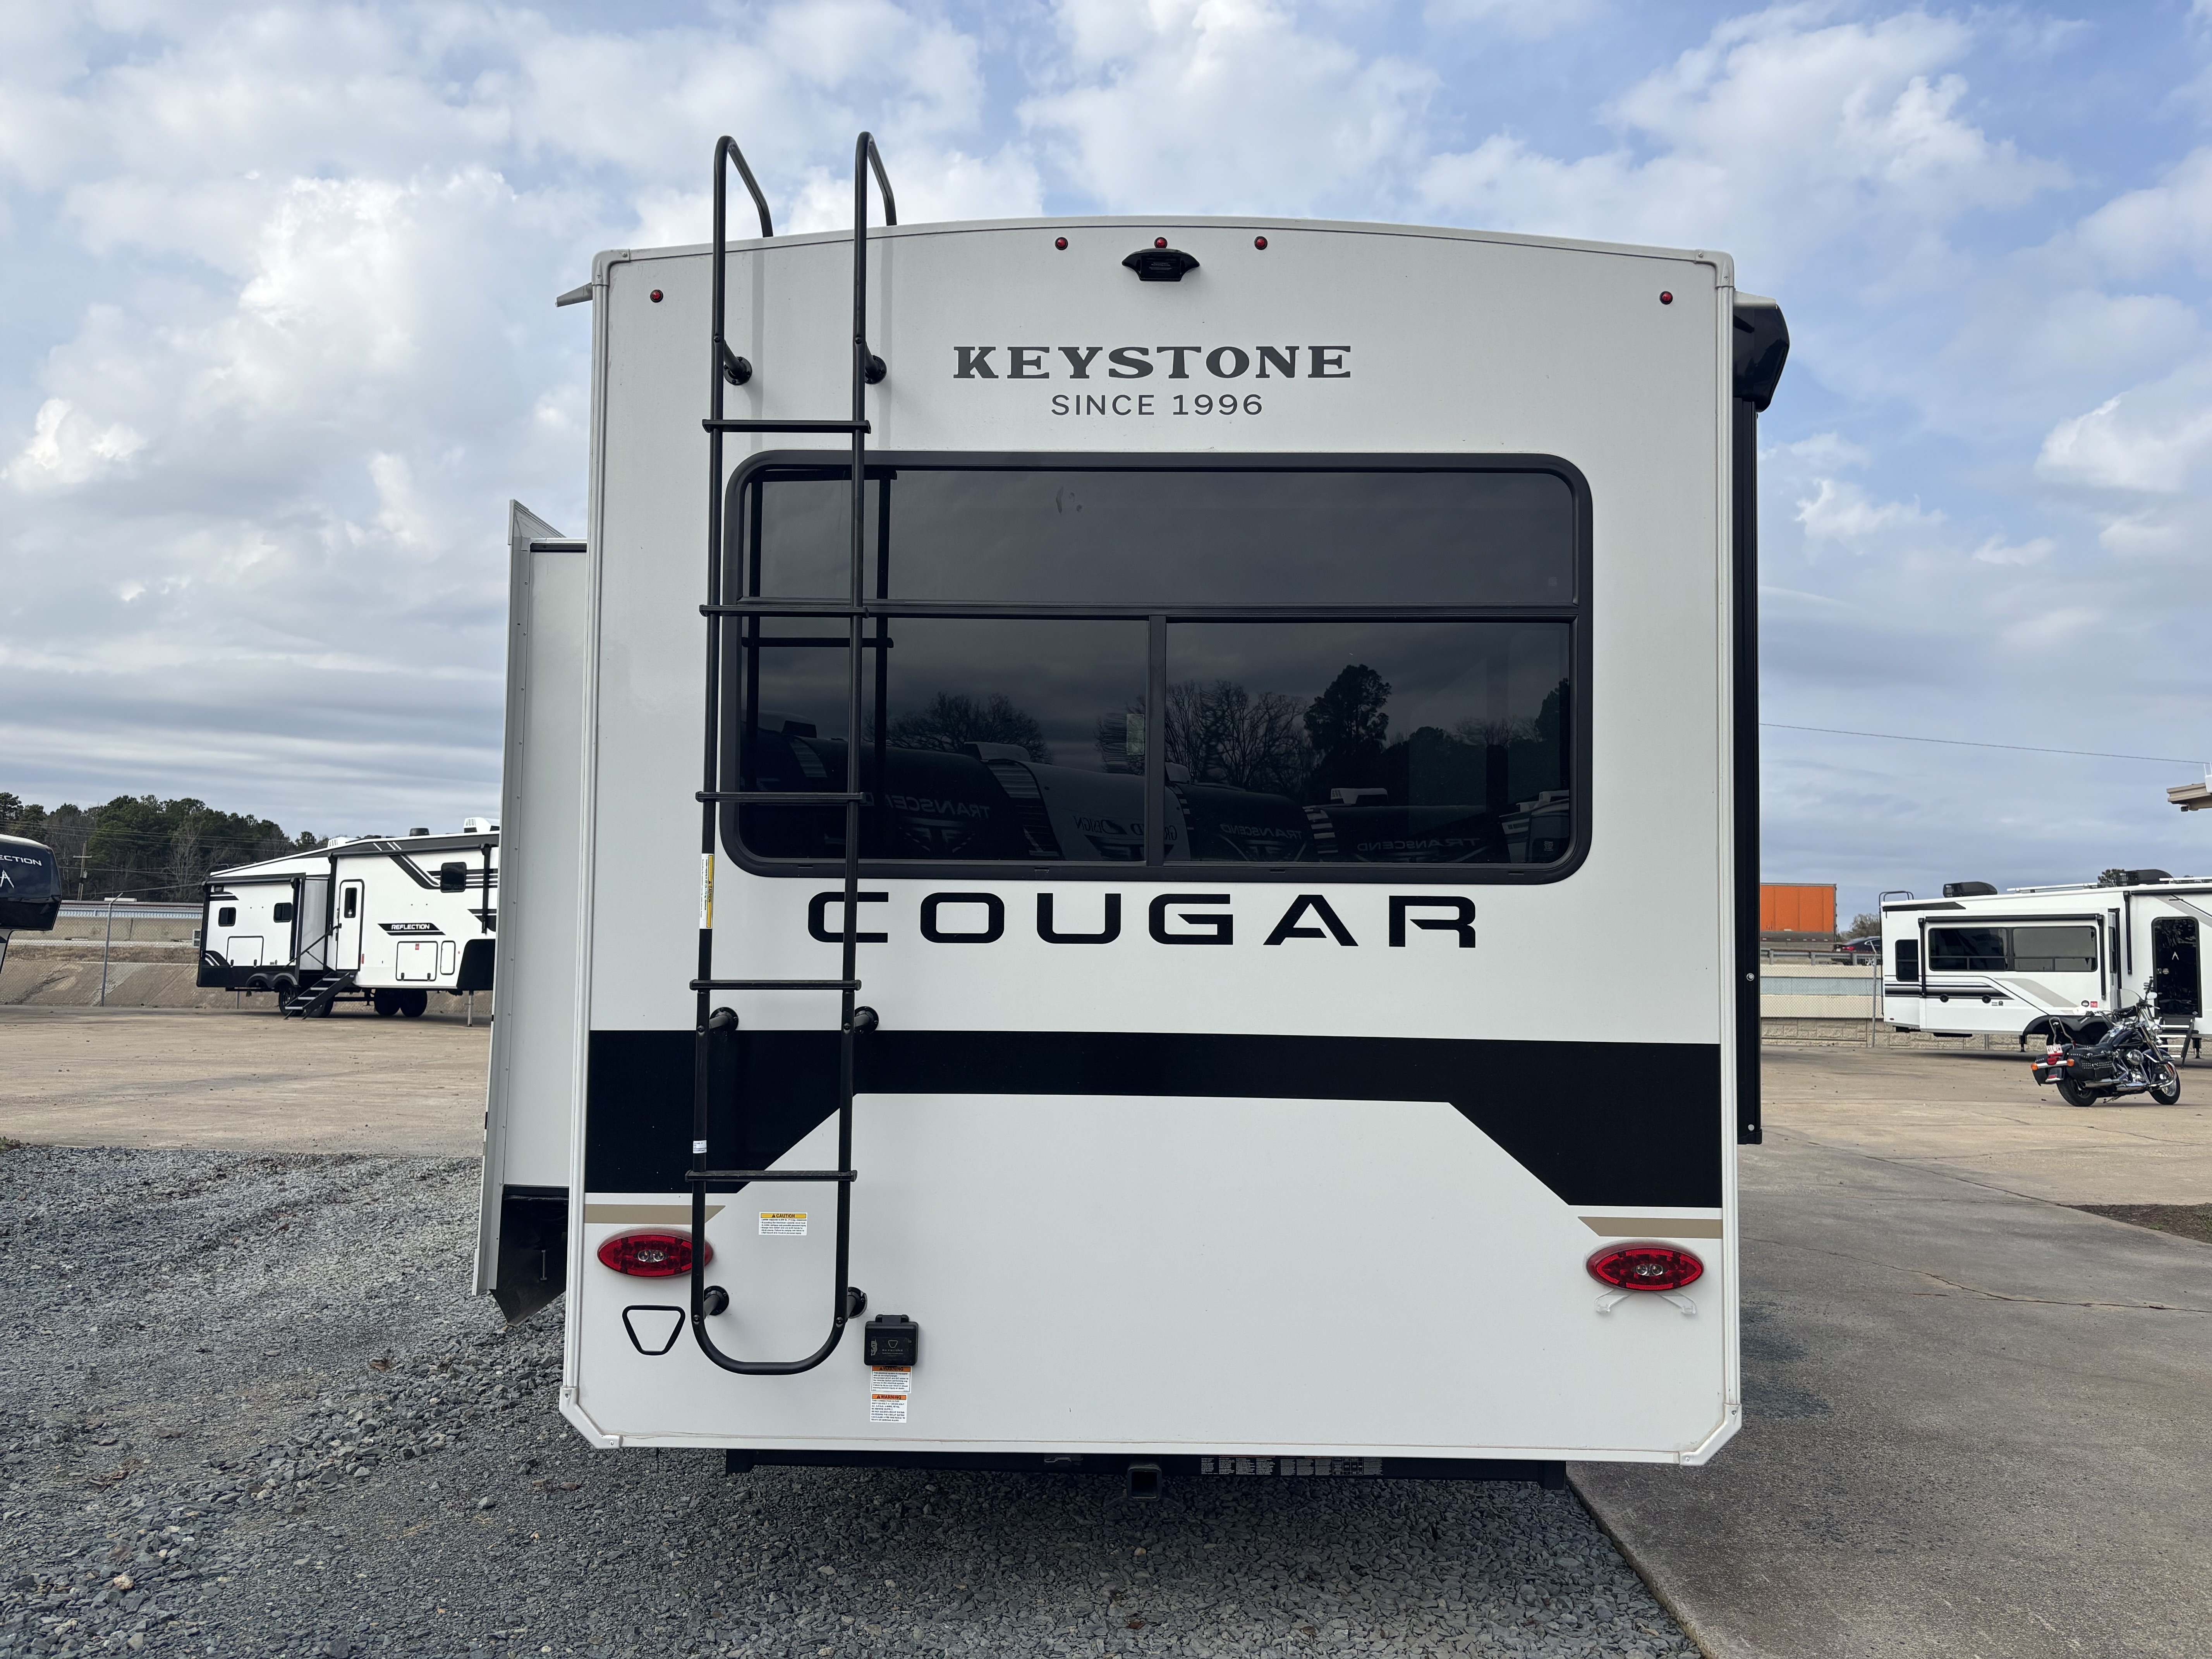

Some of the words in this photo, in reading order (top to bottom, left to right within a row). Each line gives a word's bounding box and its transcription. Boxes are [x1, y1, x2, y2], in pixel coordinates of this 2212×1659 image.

[953, 345, 1351, 379] KEYSTONE
[1051, 394, 1154, 416] SINCE
[1173, 394, 1262, 416] 1996
[808, 891, 1476, 948] COUGAR
